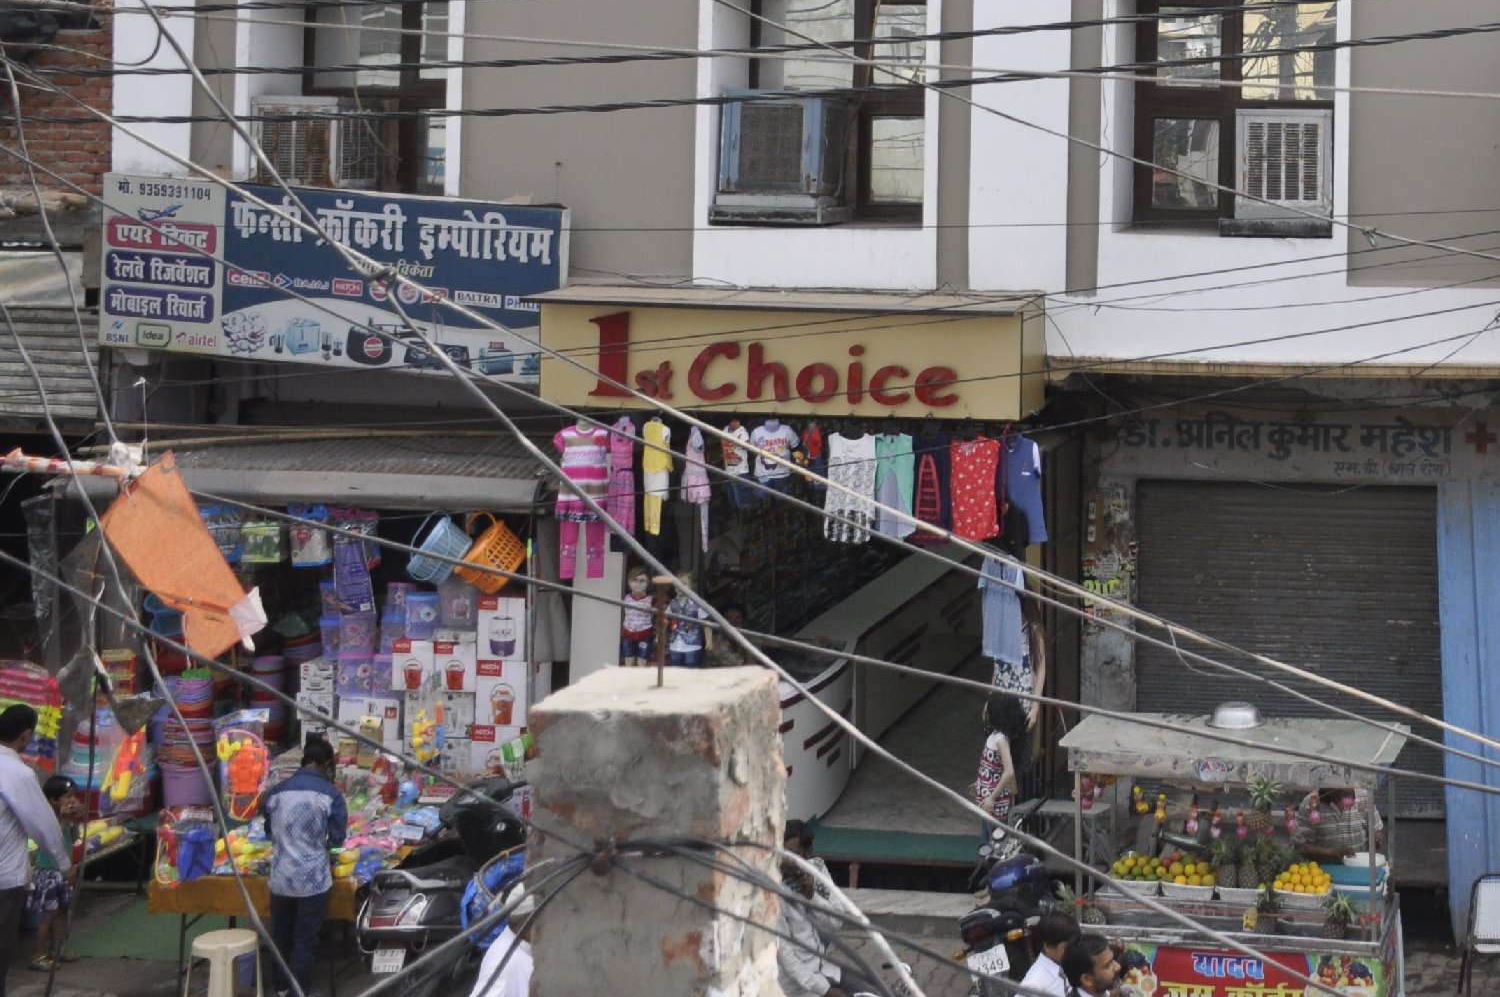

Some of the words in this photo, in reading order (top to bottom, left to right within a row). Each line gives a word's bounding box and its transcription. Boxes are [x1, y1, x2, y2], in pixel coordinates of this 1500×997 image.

[139, 183, 211, 200] 9359331104
[115, 224, 152, 244] एयर
[160, 222, 209, 249] टिकट
[418, 209, 554, 265] इम्पोरियम
[111, 254, 145, 279] रेलवे
[110, 288, 162, 316] मोबाइल
[457, 292, 498, 304] BALTRA
[106, 332, 130, 343] BSNL
[188, 334, 217, 347] airtel
[588, 311, 674, 400] 1st
[687, 341, 960, 407] Choice
[1267, 420, 1352, 460] कुमार
[1359, 415, 1452, 458] महेश
[1191, 951, 1265, 980] यादव
